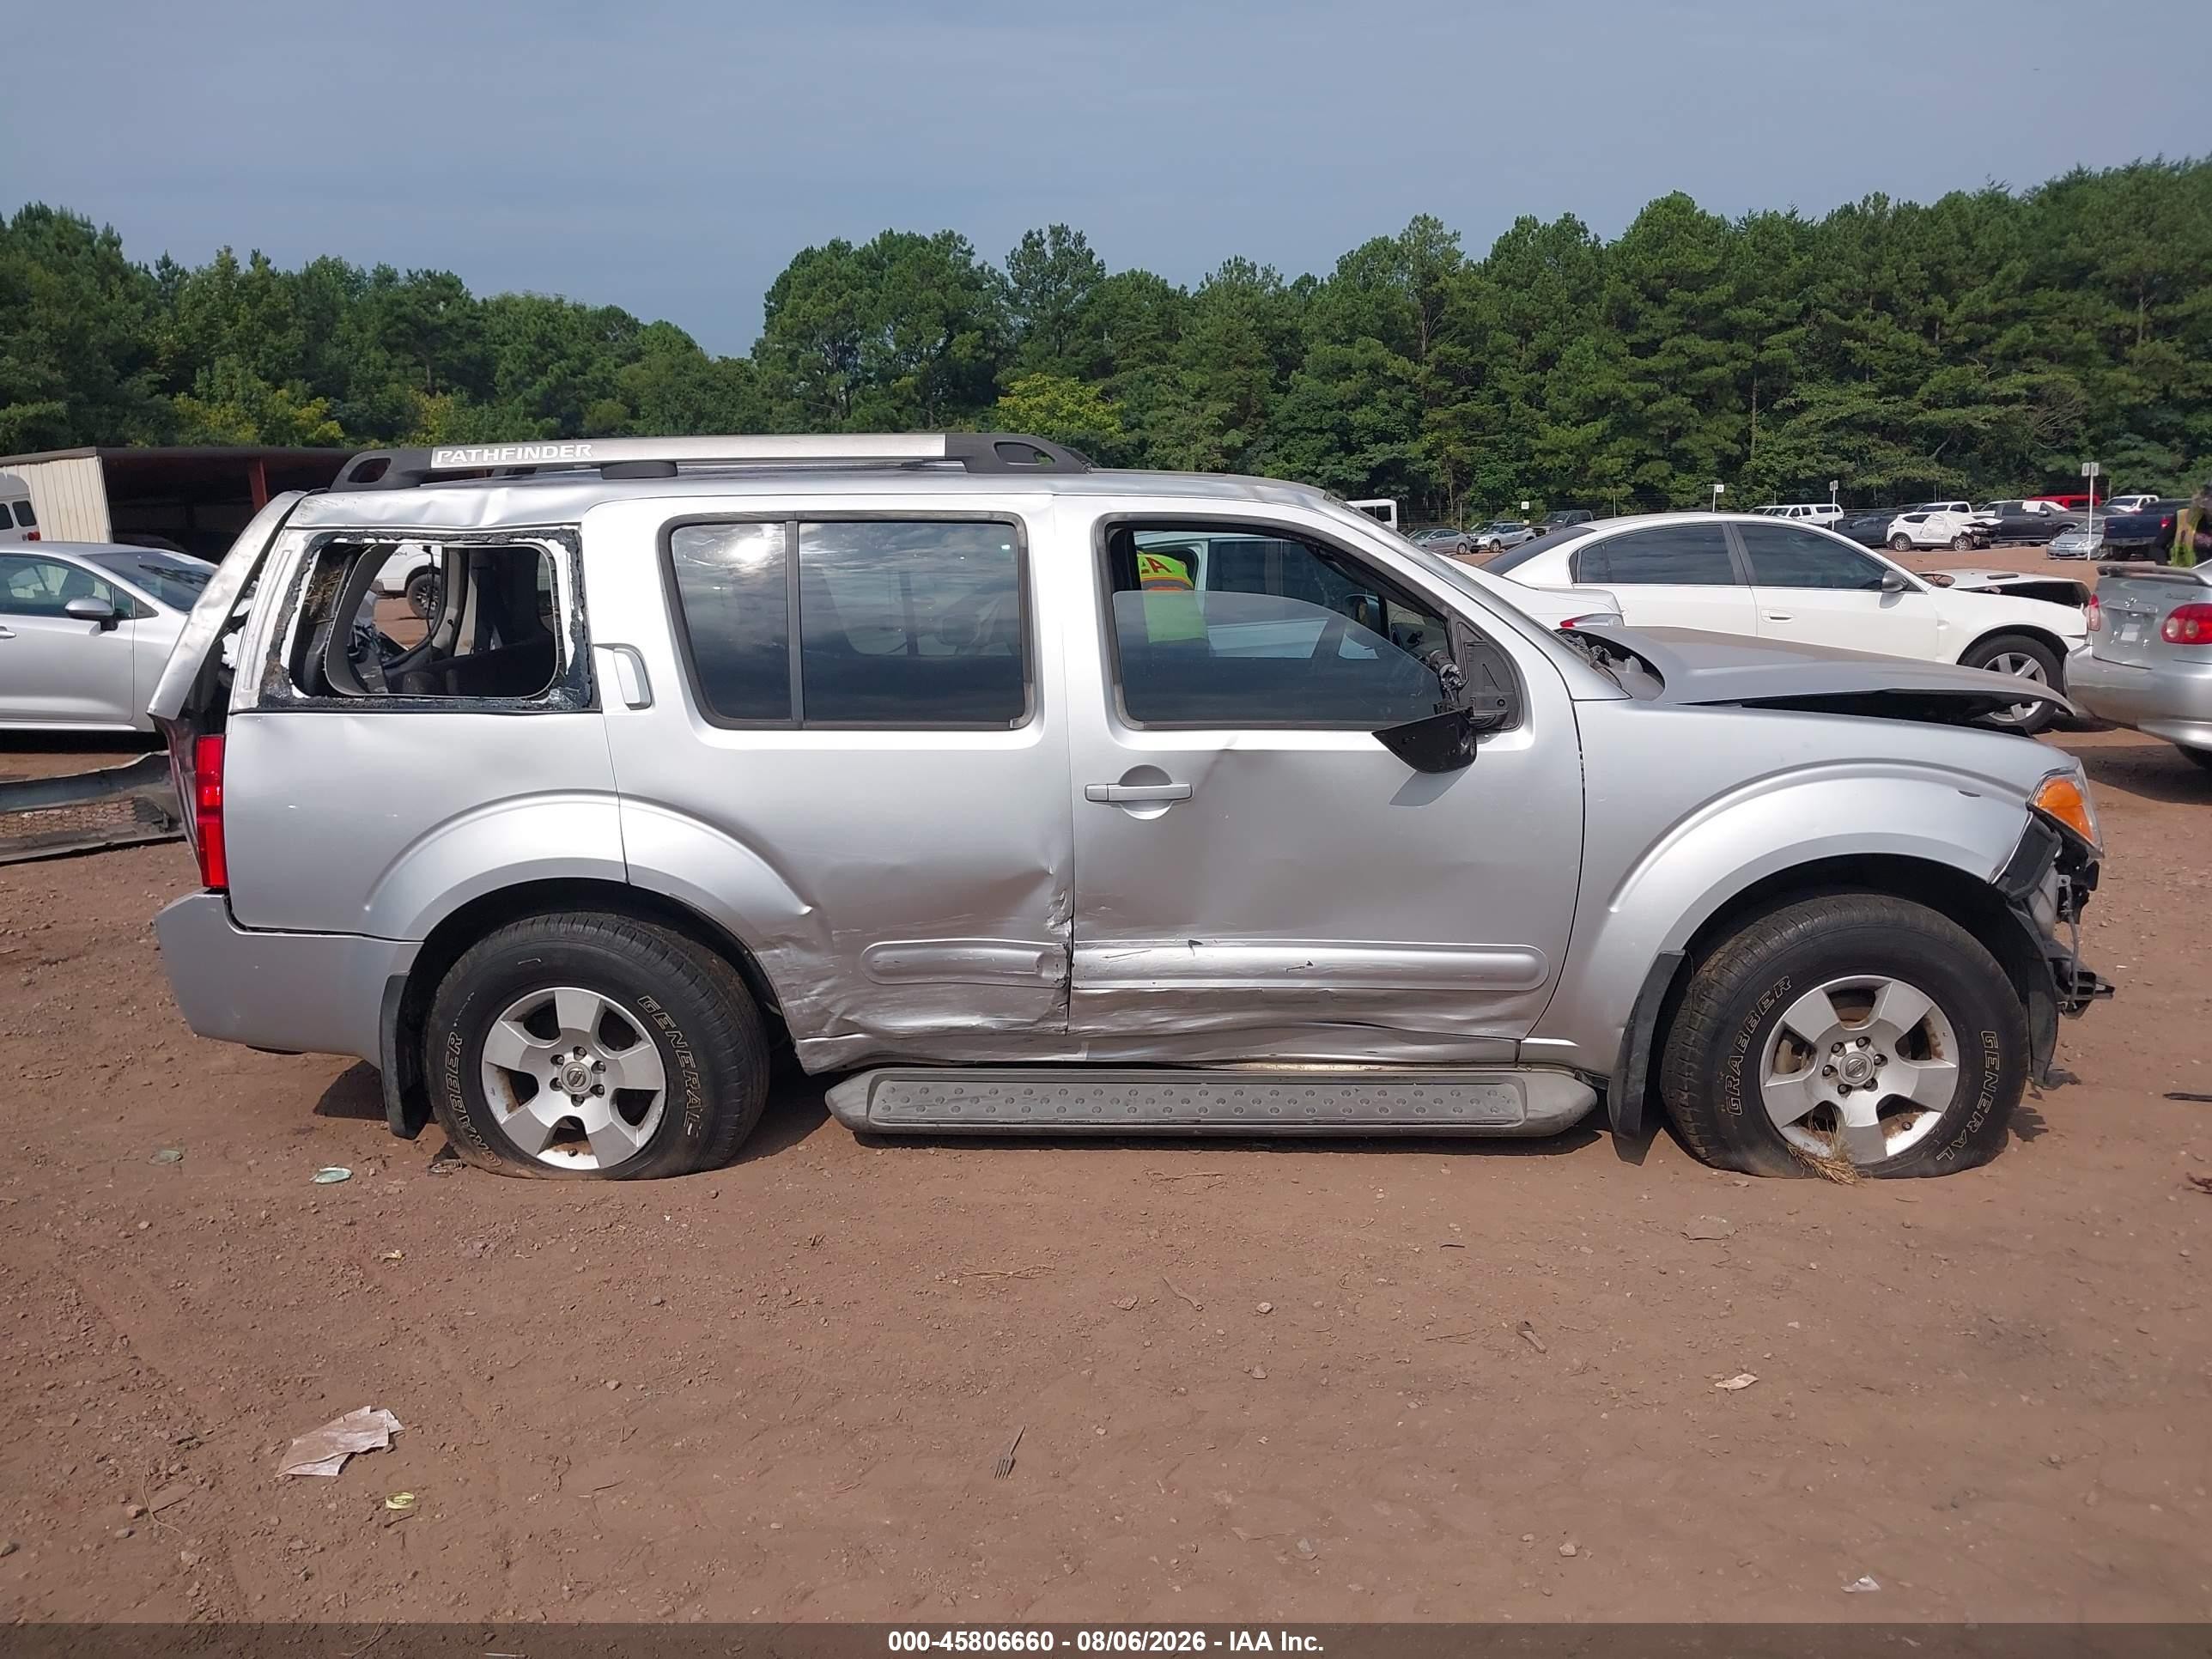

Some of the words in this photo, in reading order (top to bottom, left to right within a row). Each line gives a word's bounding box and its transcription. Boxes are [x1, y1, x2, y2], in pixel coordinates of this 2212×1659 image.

[436, 443, 592, 464] PATHFINDER
[637, 994, 702, 1136] GENERAL
[1724, 975, 1792, 1116] GRABBER
[1936, 1030, 2000, 1161] GENERAL
